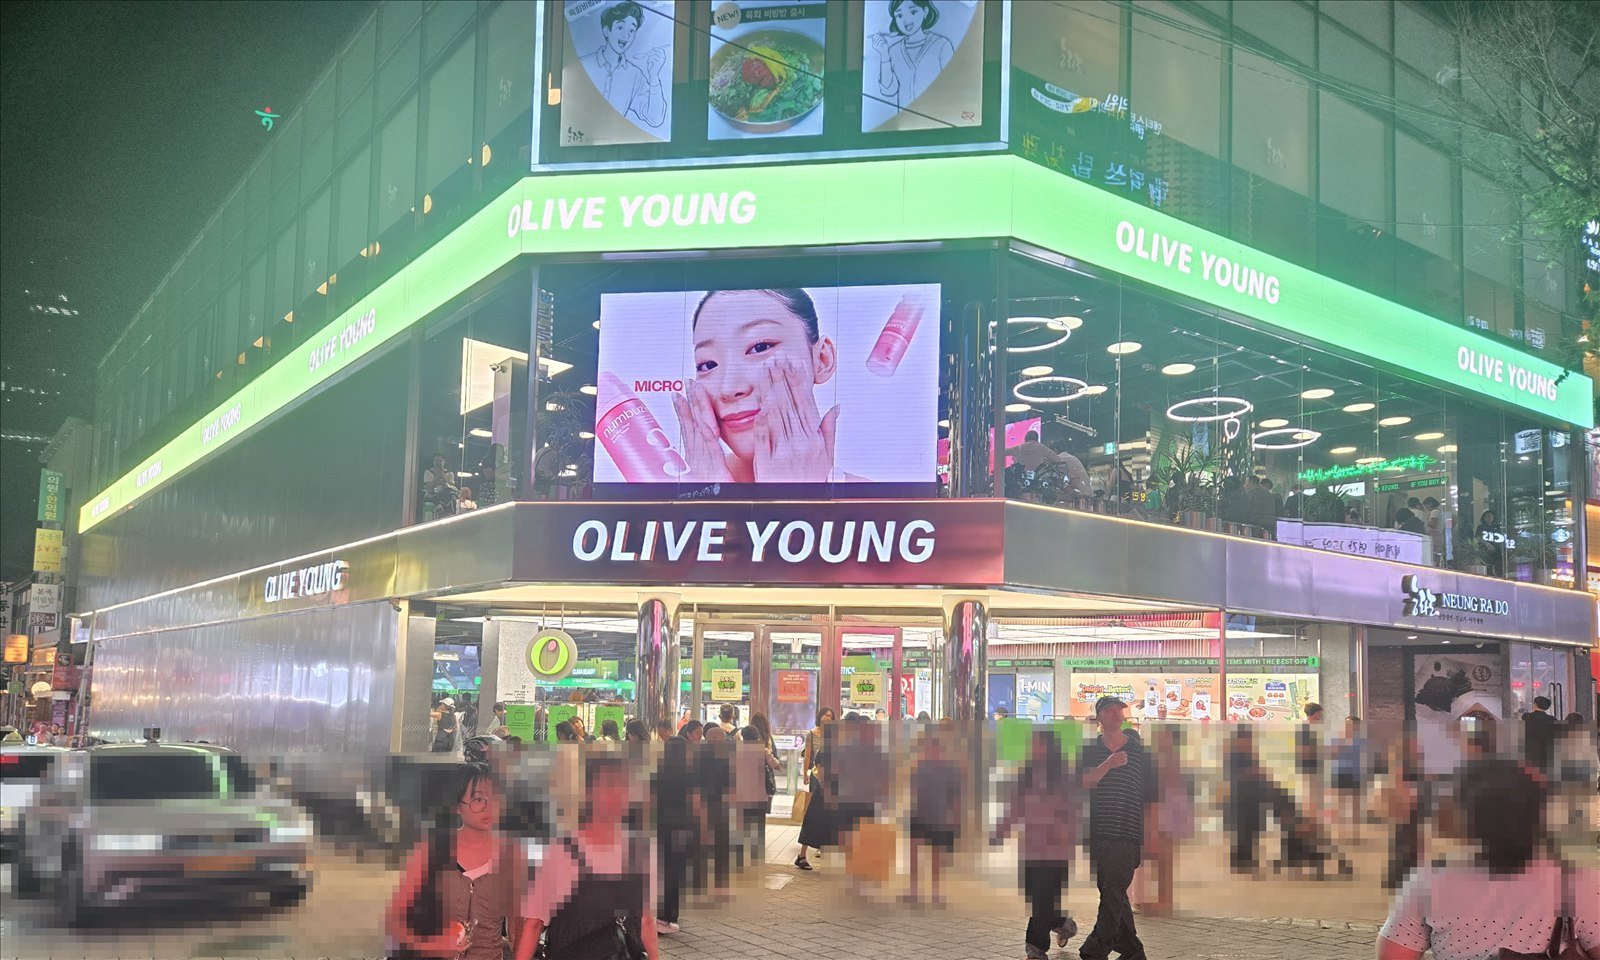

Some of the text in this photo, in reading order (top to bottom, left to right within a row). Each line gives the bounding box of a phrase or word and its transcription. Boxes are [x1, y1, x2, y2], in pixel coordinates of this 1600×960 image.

[716, 9, 740, 24] NEW!
[507, 190, 757, 239] OLIVE YOUNG
[1116, 220, 1280, 305] OLIVE YOUNG
[308, 308, 376, 372] OLIVE YOUNG
[634, 380, 683, 392] MICRO
[1457, 346, 1557, 401] OLIVE YOUNG
[572, 519, 936, 564] OLIVE YOUNG
[265, 560, 345, 602] OLIVE YOUNG
[1442, 593, 1509, 615] NEUNG RA DO
[1019, 678, 1051, 694] 1-MIN
